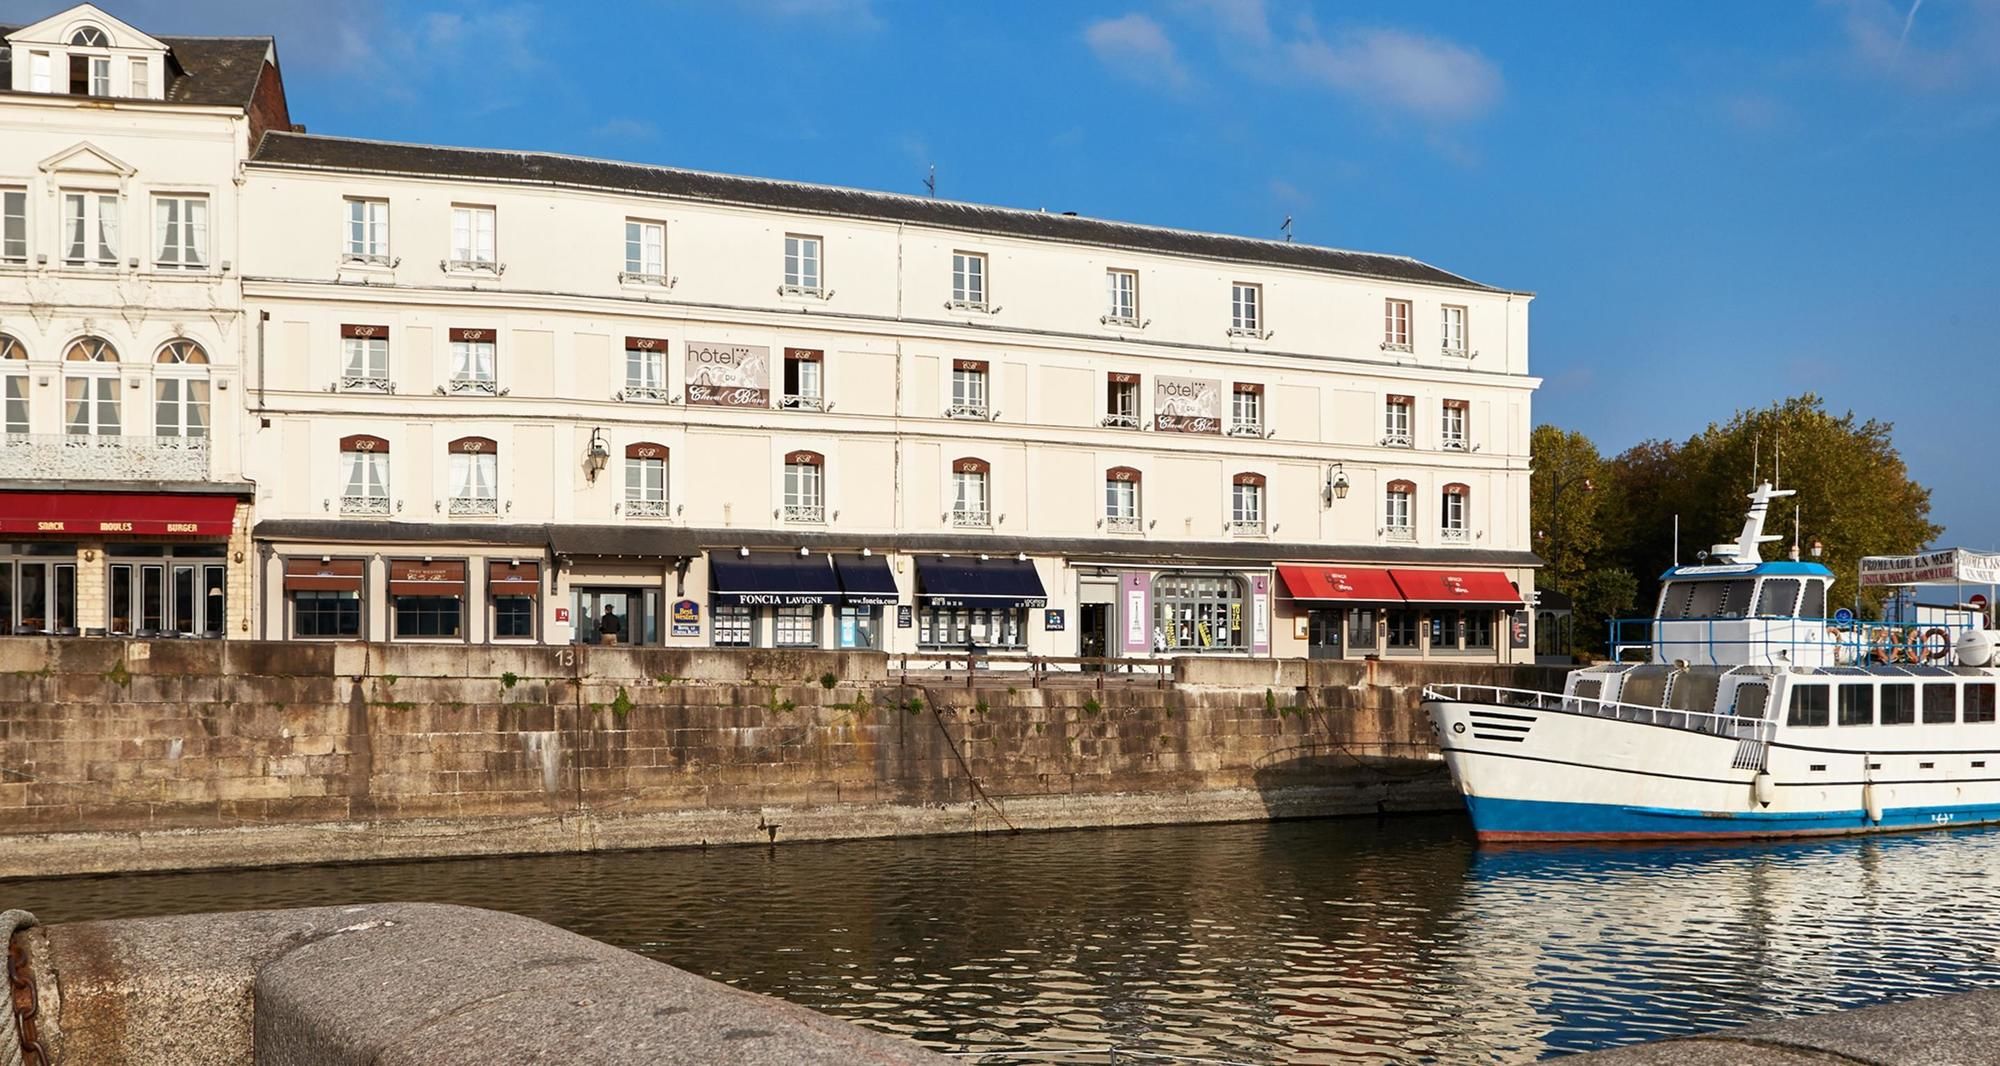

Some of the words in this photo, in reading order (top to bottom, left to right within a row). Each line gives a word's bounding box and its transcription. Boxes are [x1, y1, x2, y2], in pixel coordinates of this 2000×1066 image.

[688, 344, 735, 364] hôtel
[1157, 380, 1194, 397] hôtel
[38, 522, 64, 531] SNACK
[100, 522, 132, 531] MOULES
[167, 523, 198, 532] BURGER
[1862, 558, 1913, 571] PROMENADE
[1915, 556, 1929, 568] EN
[1931, 552, 1953, 565] MER
[740, 595, 781, 604] FONCIA
[785, 596, 823, 604] LAVIGNE
[848, 596, 898, 605] www.foncia.com
[555, 650, 574, 666] 13
